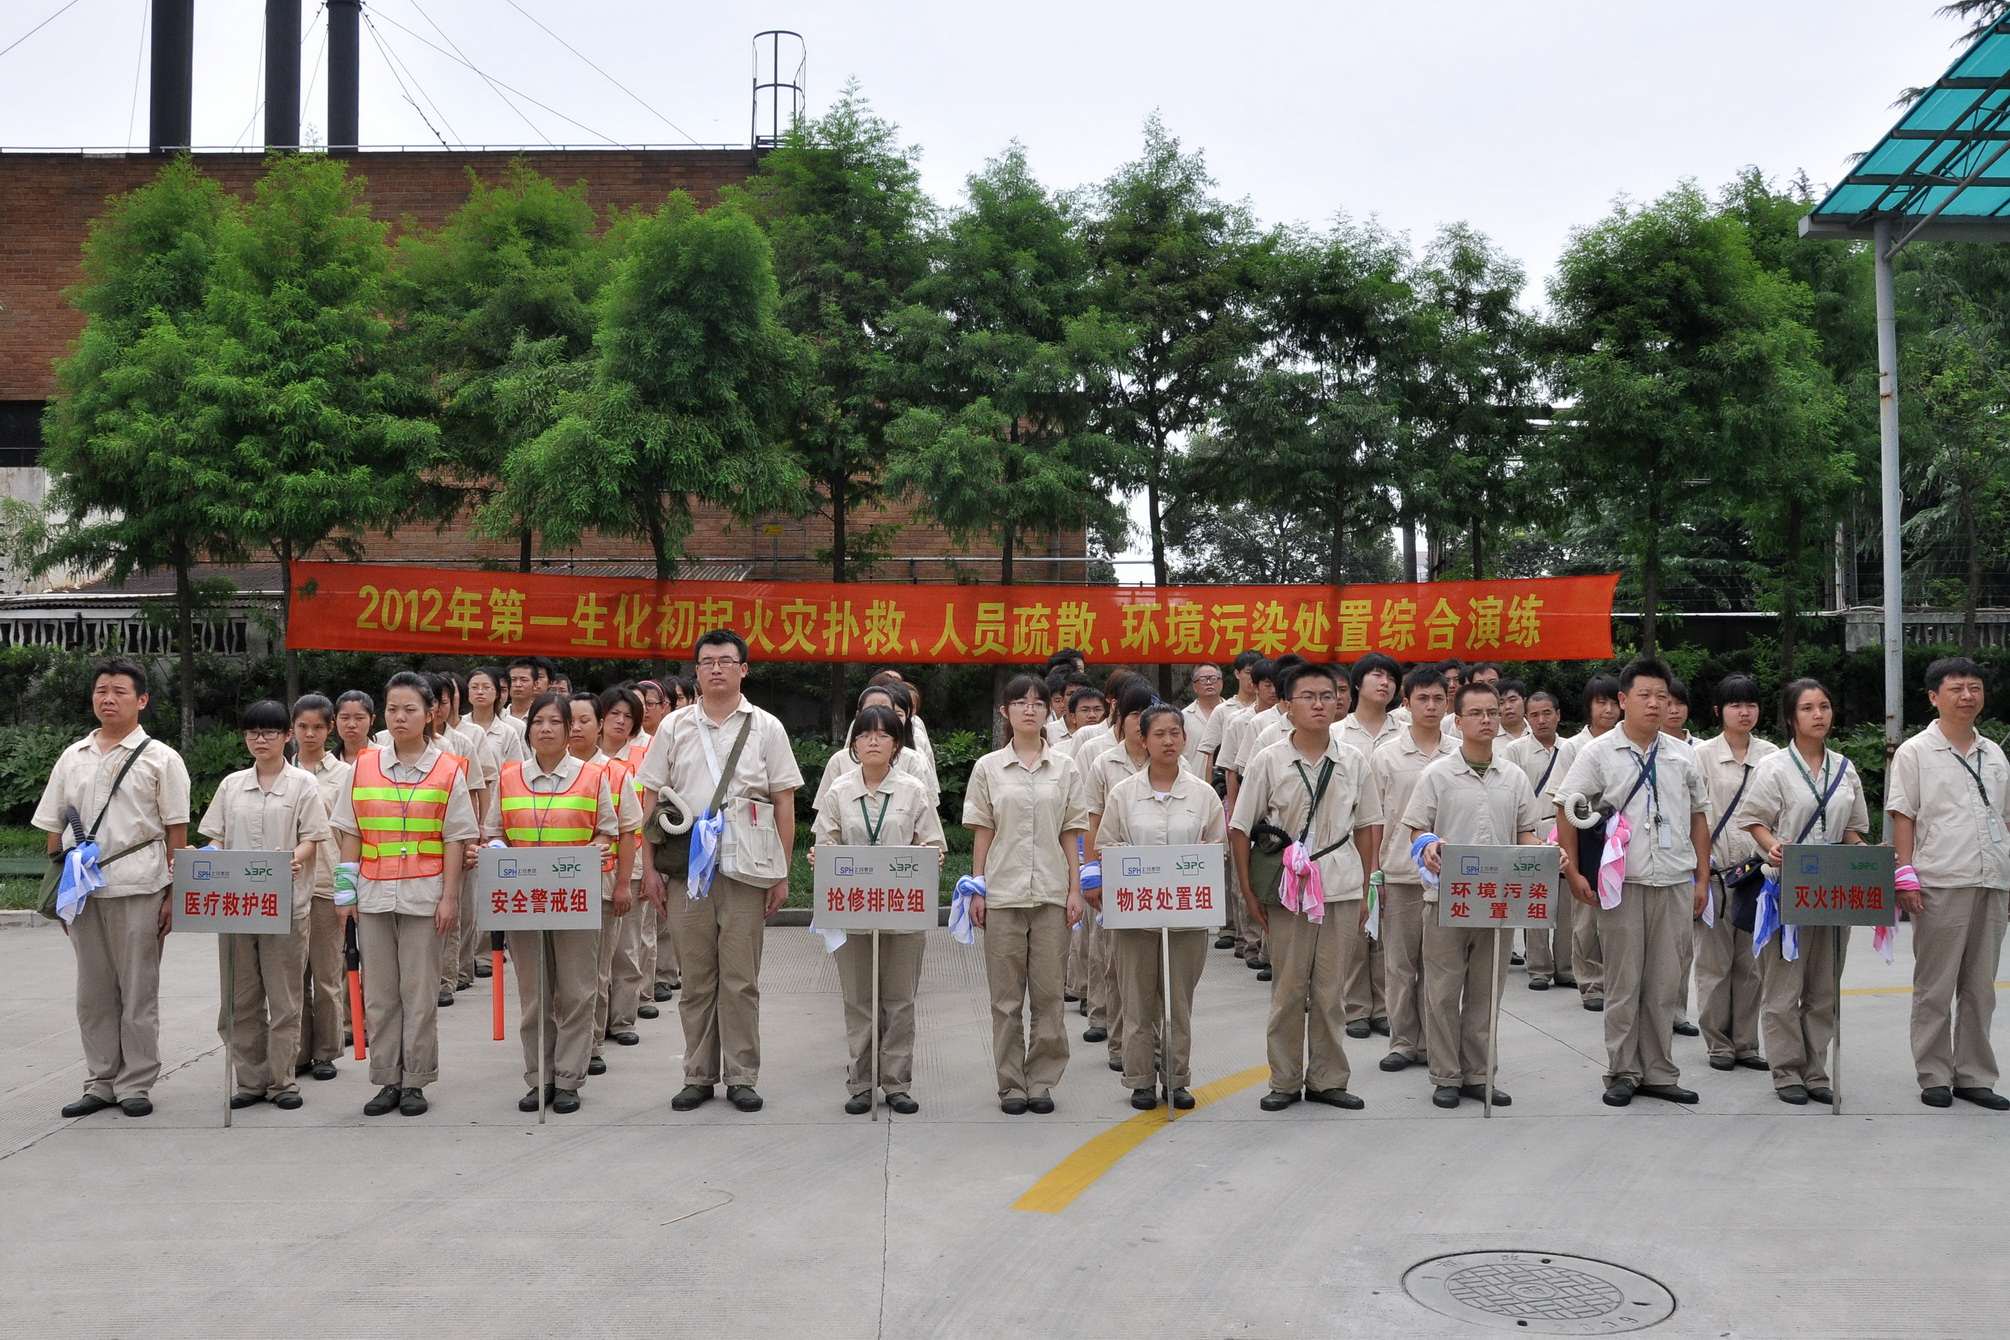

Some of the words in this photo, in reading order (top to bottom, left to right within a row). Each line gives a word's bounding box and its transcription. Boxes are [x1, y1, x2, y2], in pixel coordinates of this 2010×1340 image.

[197, 870, 211, 878] SPH
[503, 868, 517, 877] SPH
[840, 867, 854, 875] SPH
[1127, 867, 1141, 875] SPH
[1466, 866, 1480, 874] SPH
[1116, 886, 1213, 912] 物资处置组
[1450, 882, 1548, 899] 环境污染
[1794, 885, 1885, 910] 灭火扑救组
[184, 891, 279, 917] 医疗救护组
[491, 888, 589, 914] 安全警戒组
[827, 887, 925, 913] 抢修排险组
[1450, 902, 1548, 919] 处置组
